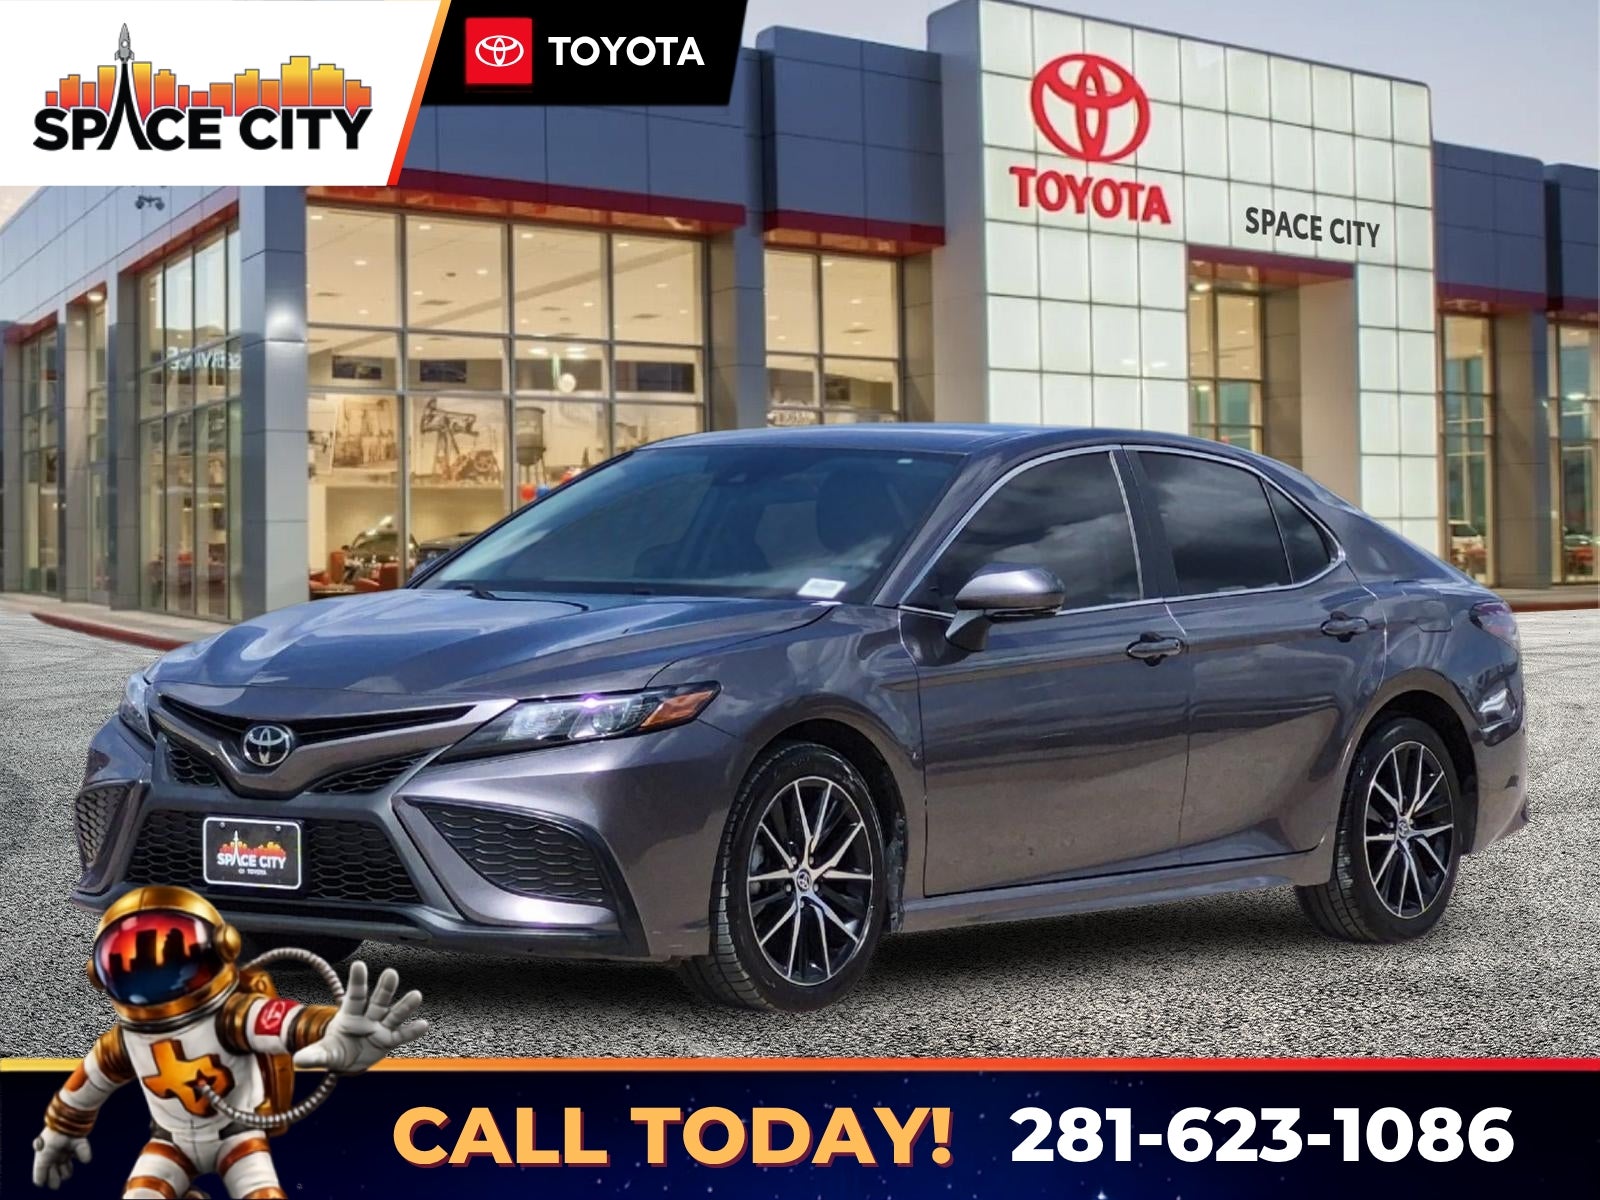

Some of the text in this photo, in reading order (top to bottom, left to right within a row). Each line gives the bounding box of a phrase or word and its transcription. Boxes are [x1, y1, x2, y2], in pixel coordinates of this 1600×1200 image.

[1009, 165, 1171, 224] TOYOTA
[1245, 206, 1381, 248] SPACE CITY
[216, 852, 287, 870] SPACE CITY
